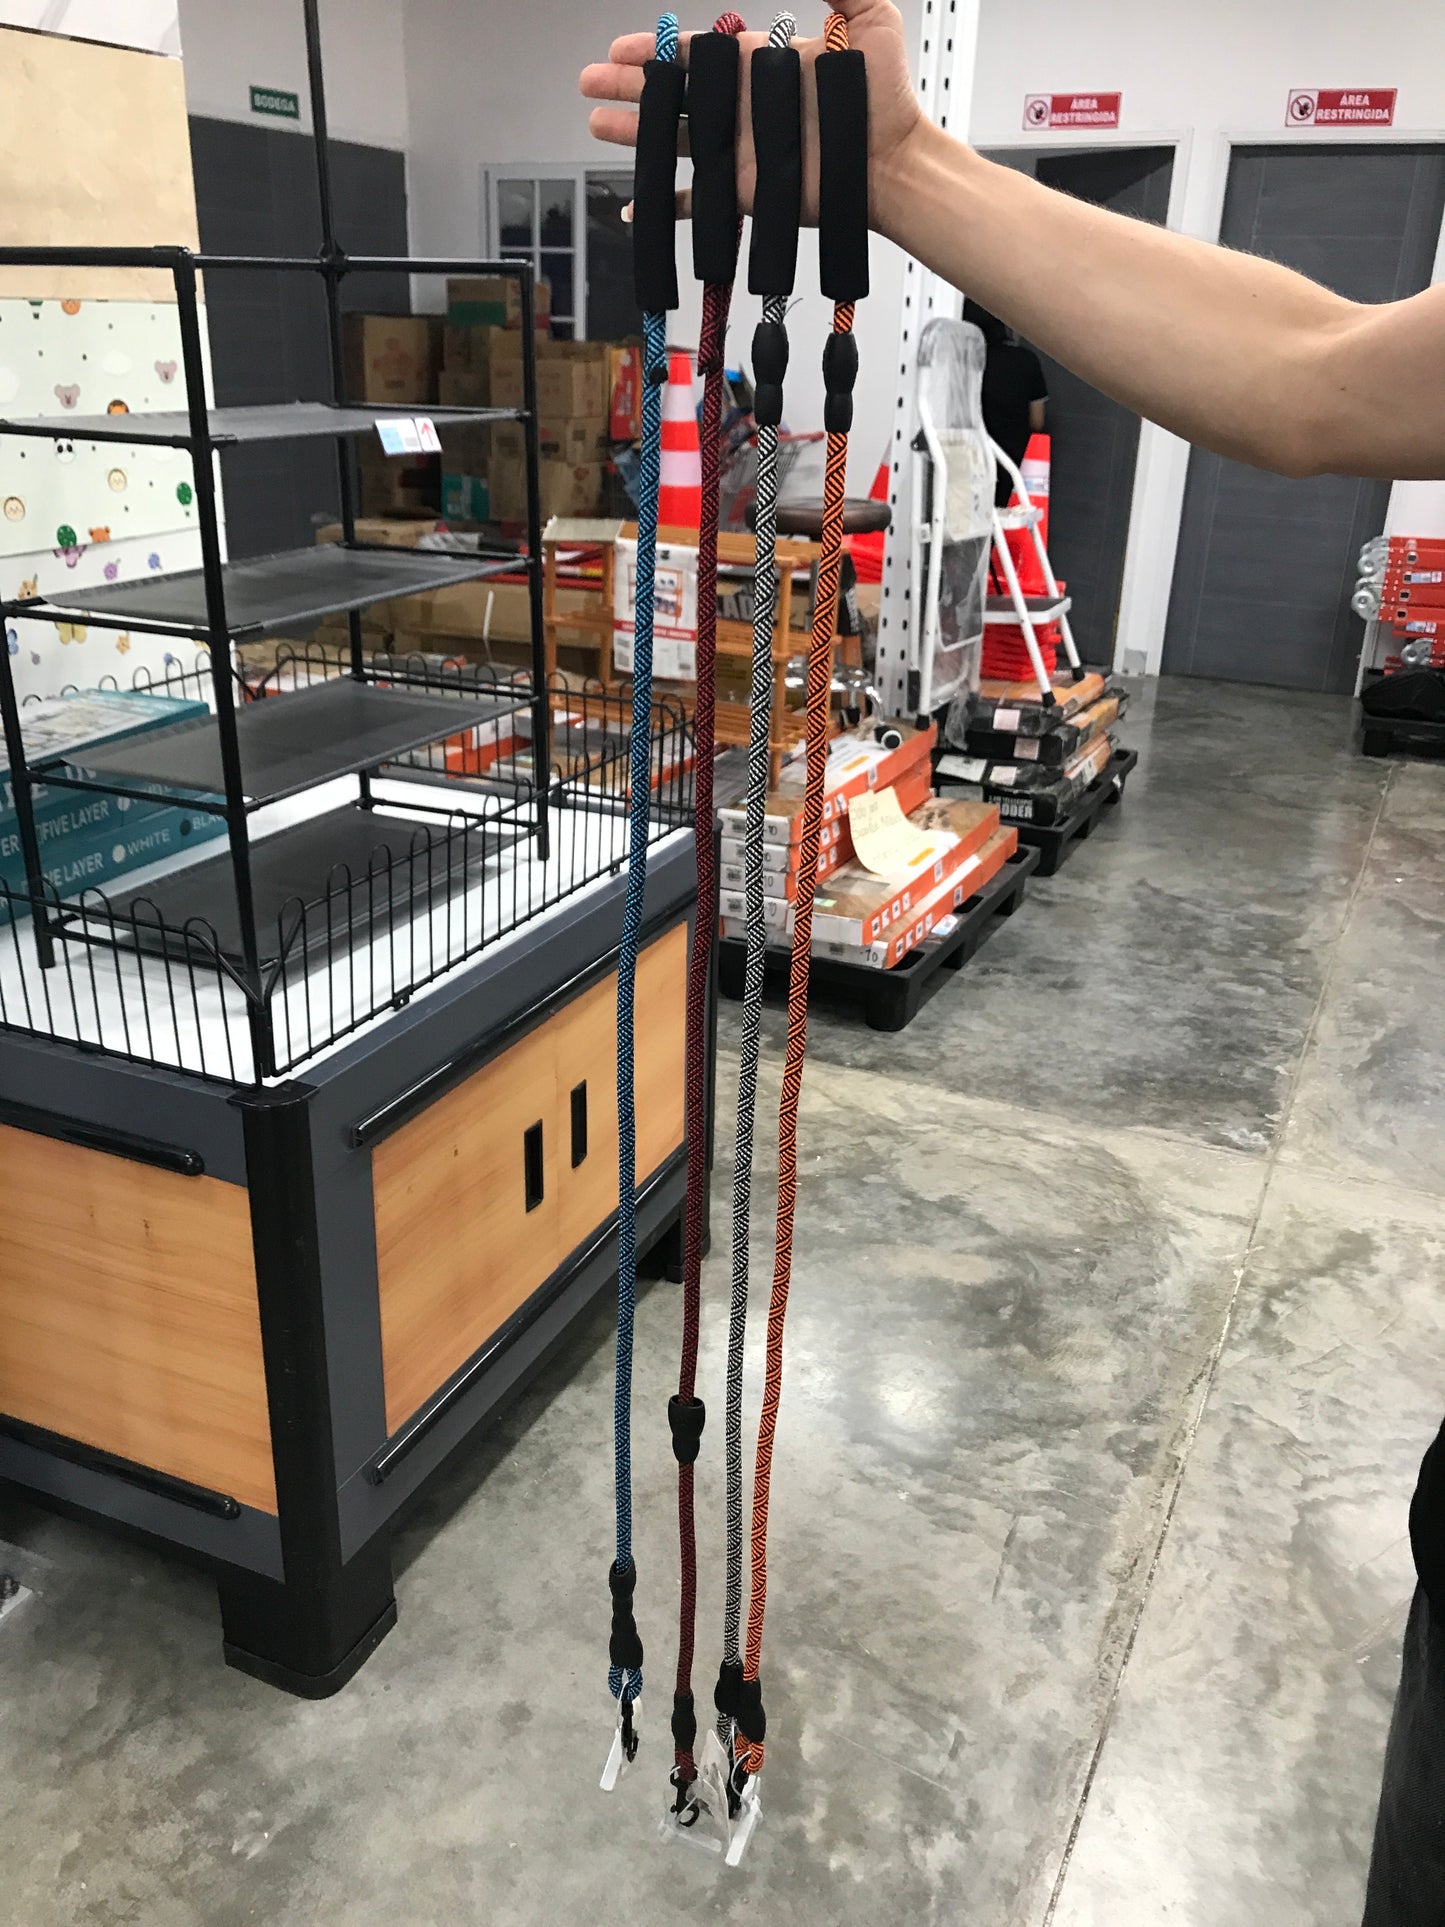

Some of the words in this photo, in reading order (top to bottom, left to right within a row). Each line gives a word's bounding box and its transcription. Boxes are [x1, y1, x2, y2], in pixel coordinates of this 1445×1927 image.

[1340, 92, 1370, 106] ÁREA
[1049, 111, 1116, 124] RESTRINGIDA
[1316, 108, 1389, 120] RESTRINGIDA
[70, 799, 110, 830] LAYER
[127, 828, 171, 856] WHITE
[63, 851, 105, 883] LAYER
